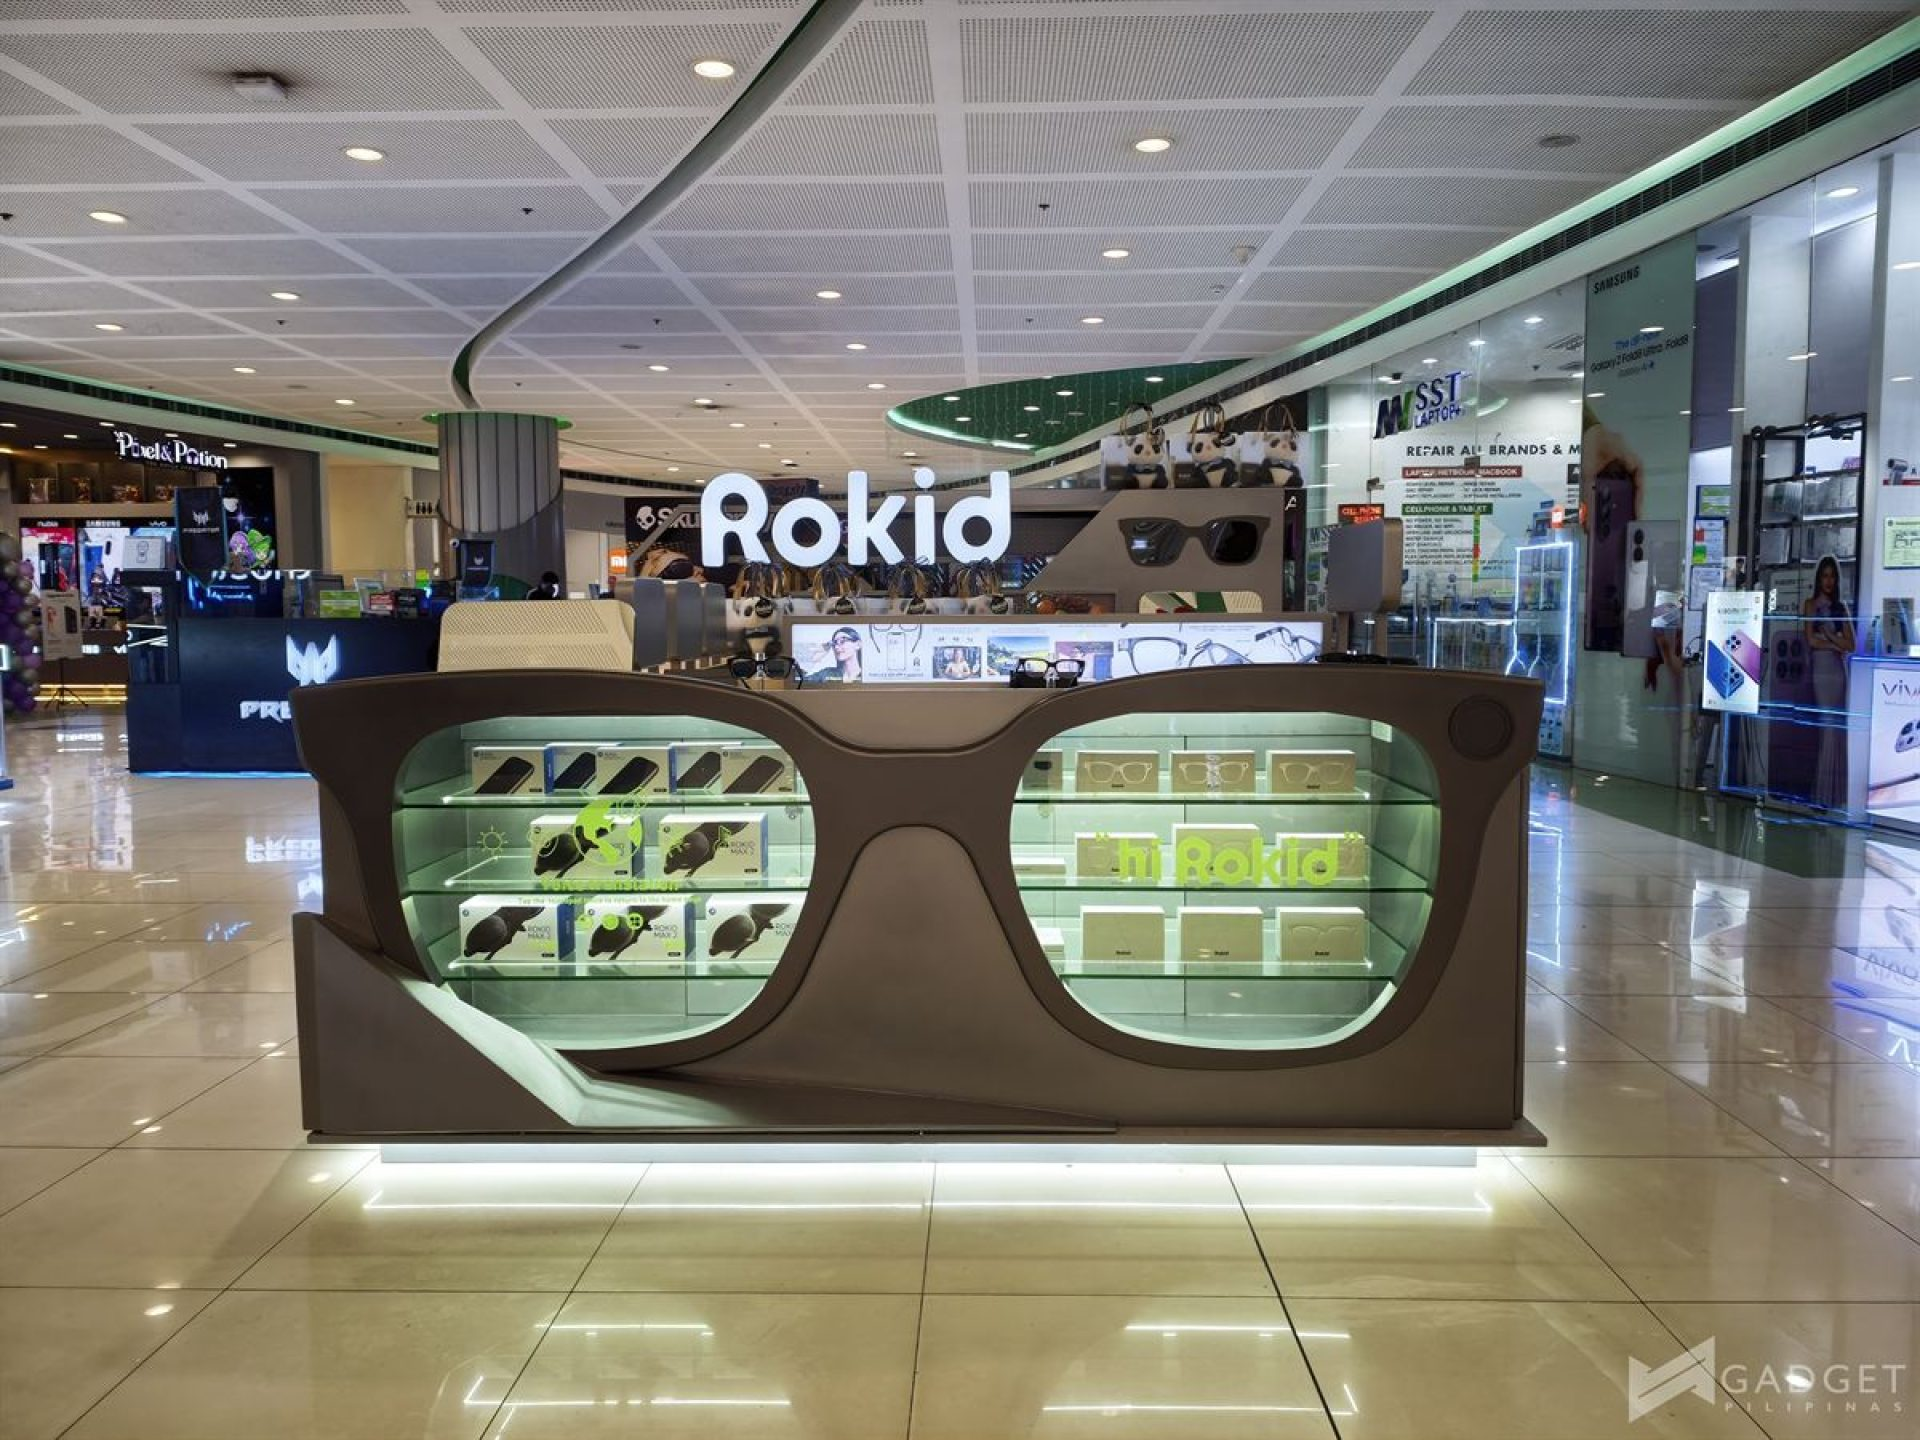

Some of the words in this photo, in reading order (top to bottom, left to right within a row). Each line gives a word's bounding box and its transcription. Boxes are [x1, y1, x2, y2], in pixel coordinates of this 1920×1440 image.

[1593, 265, 1640, 294] SAMSUNG
[1406, 445, 1455, 457] REPAIR
[1489, 444, 1548, 456] BRANDS
[1552, 444, 1563, 455] &
[700, 466, 1012, 568] Rokid
